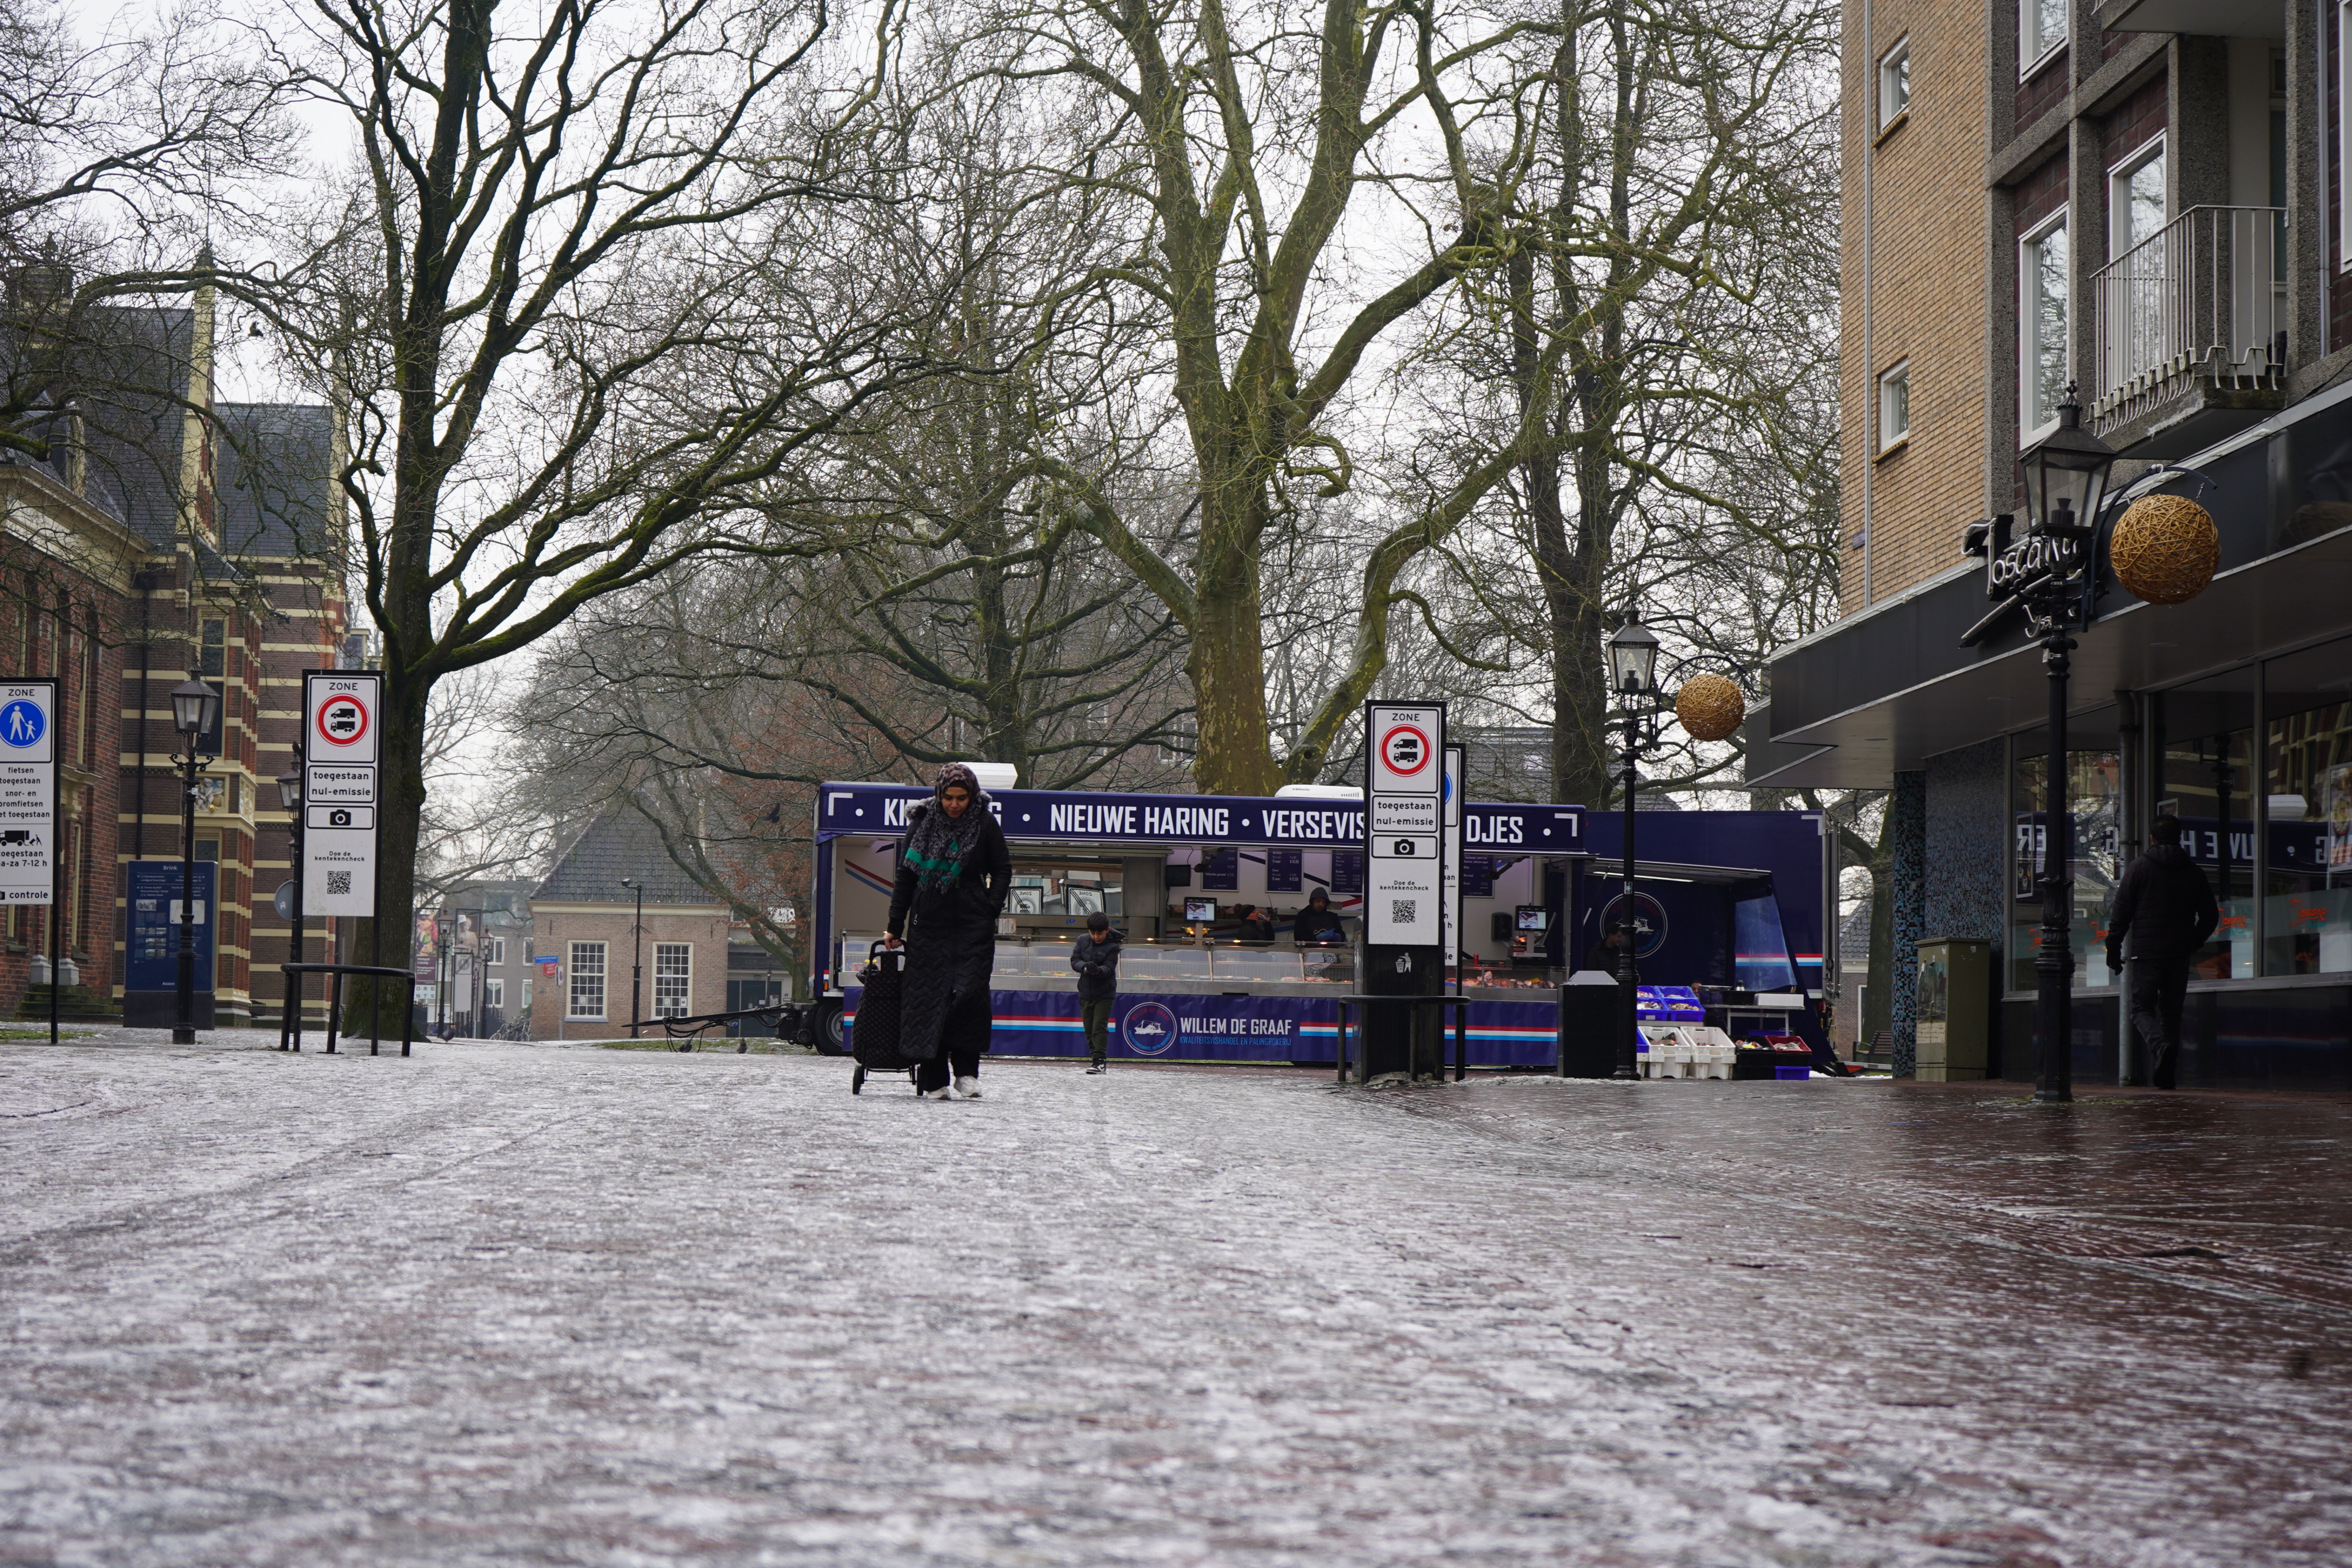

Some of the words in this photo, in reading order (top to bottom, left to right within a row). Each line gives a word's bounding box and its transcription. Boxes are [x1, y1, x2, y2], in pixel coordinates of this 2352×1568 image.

[0, 777, 41, 785] toegestaan
[314, 771, 369, 781] toegestaan
[312, 787, 371, 796] nul-emissie
[1378, 801, 1432, 811] toegestaan
[1051, 804, 1137, 834] NIEUWE
[1144, 807, 1229, 836] HARING
[1262, 809, 1364, 840] VERSEVIS
[1377, 817, 1434, 825] nul-emissie
[2290, 900, 2327, 921] Toscana
[1180, 1017, 1227, 1034] WILLEM
[1231, 1018, 1247, 1034] DE
[1251, 1019, 1292, 1035] GRAAF
[1180, 1036, 1239, 1045] KWALITEITSVISHANDEL
[1241, 1037, 1248, 1045] EN
[1249, 1038, 1291, 1046] PALINGROKERIJ
